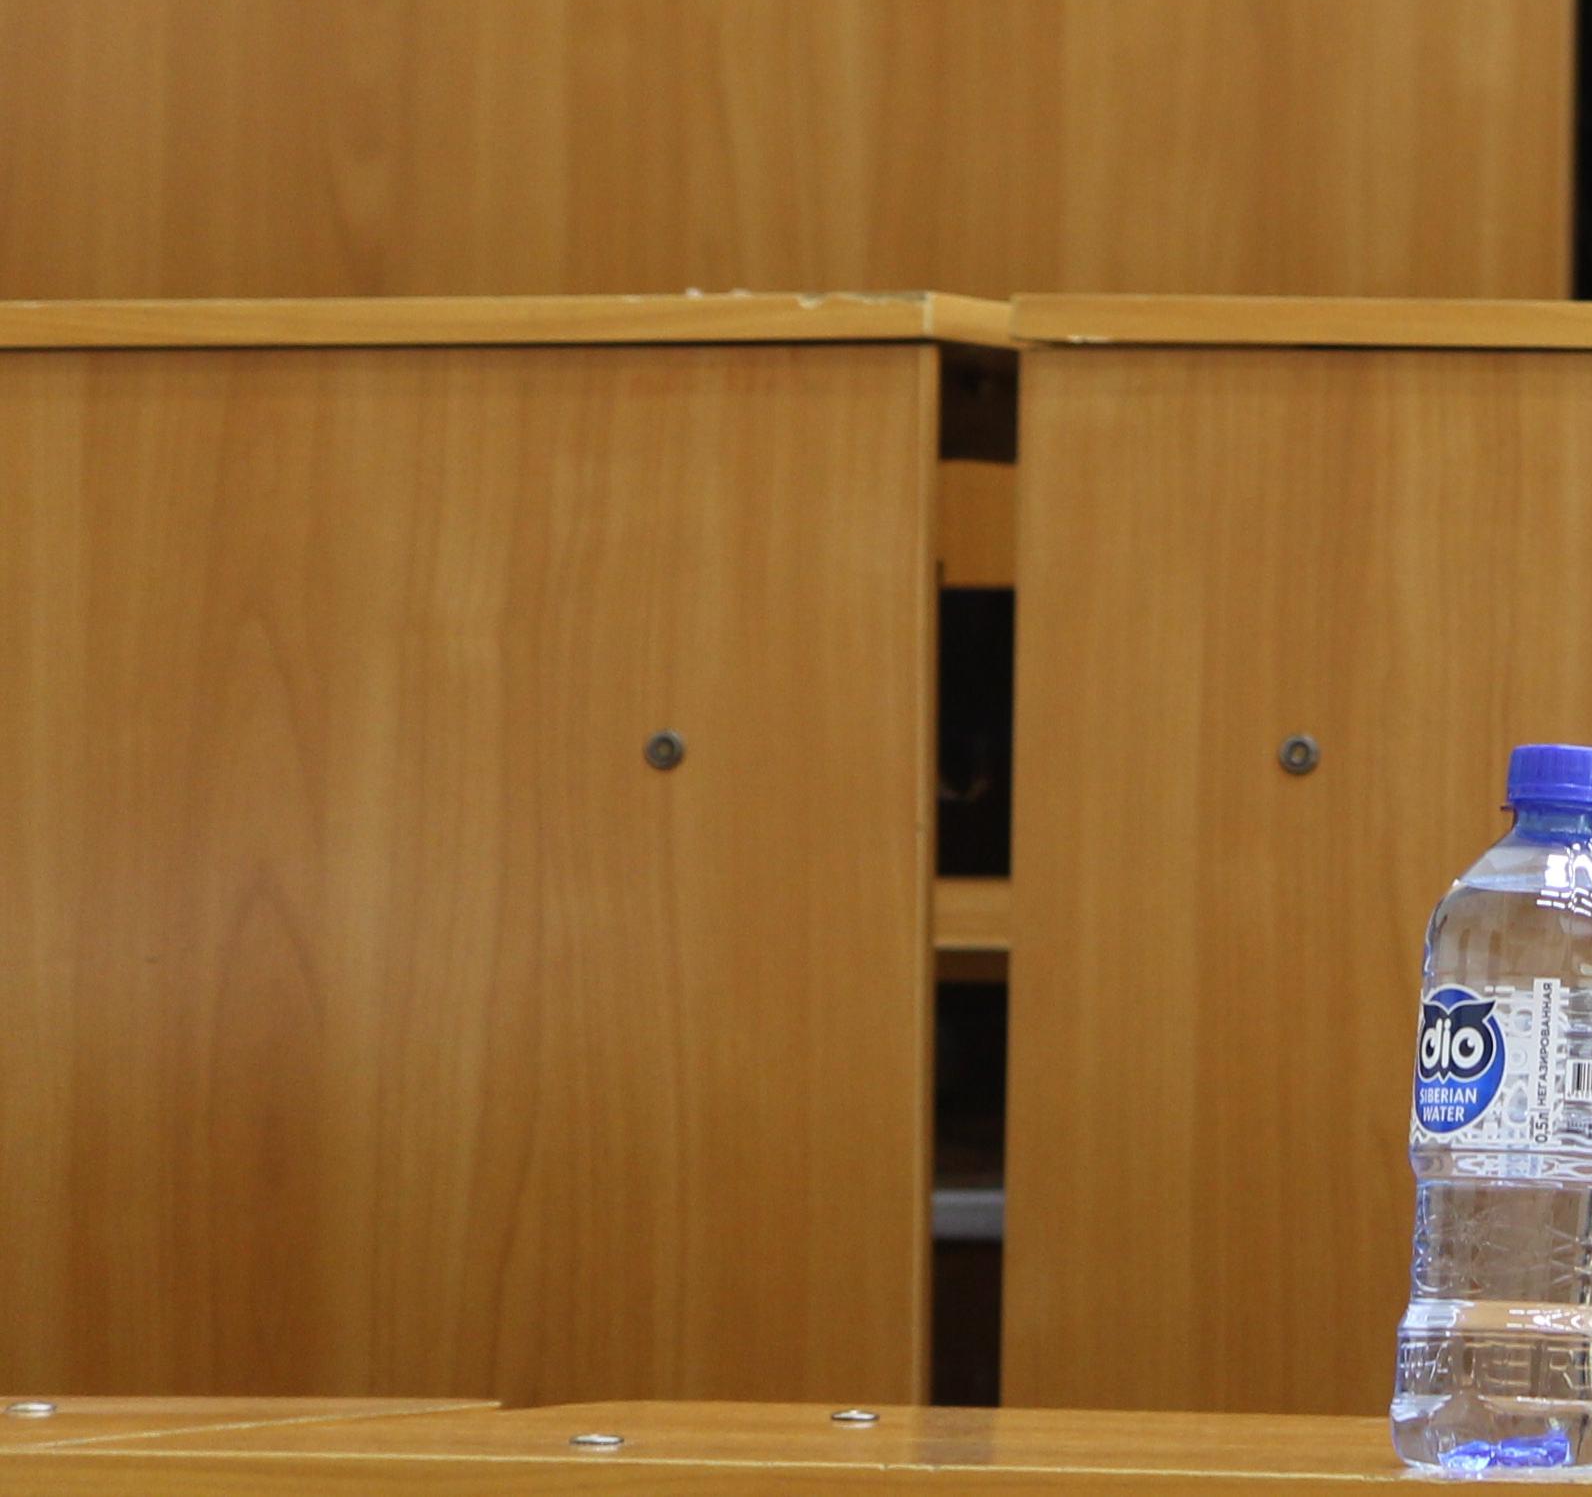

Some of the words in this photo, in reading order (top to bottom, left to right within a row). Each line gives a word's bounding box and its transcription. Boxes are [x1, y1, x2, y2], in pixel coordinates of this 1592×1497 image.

[1421, 1018, 1484, 1070] dio
[1537, 982, 1553, 1107] НЕГАЗИРОВАННАЯ
[1419, 1087, 1478, 1105] SIBERIAN
[1422, 1105, 1465, 1123] WATER
